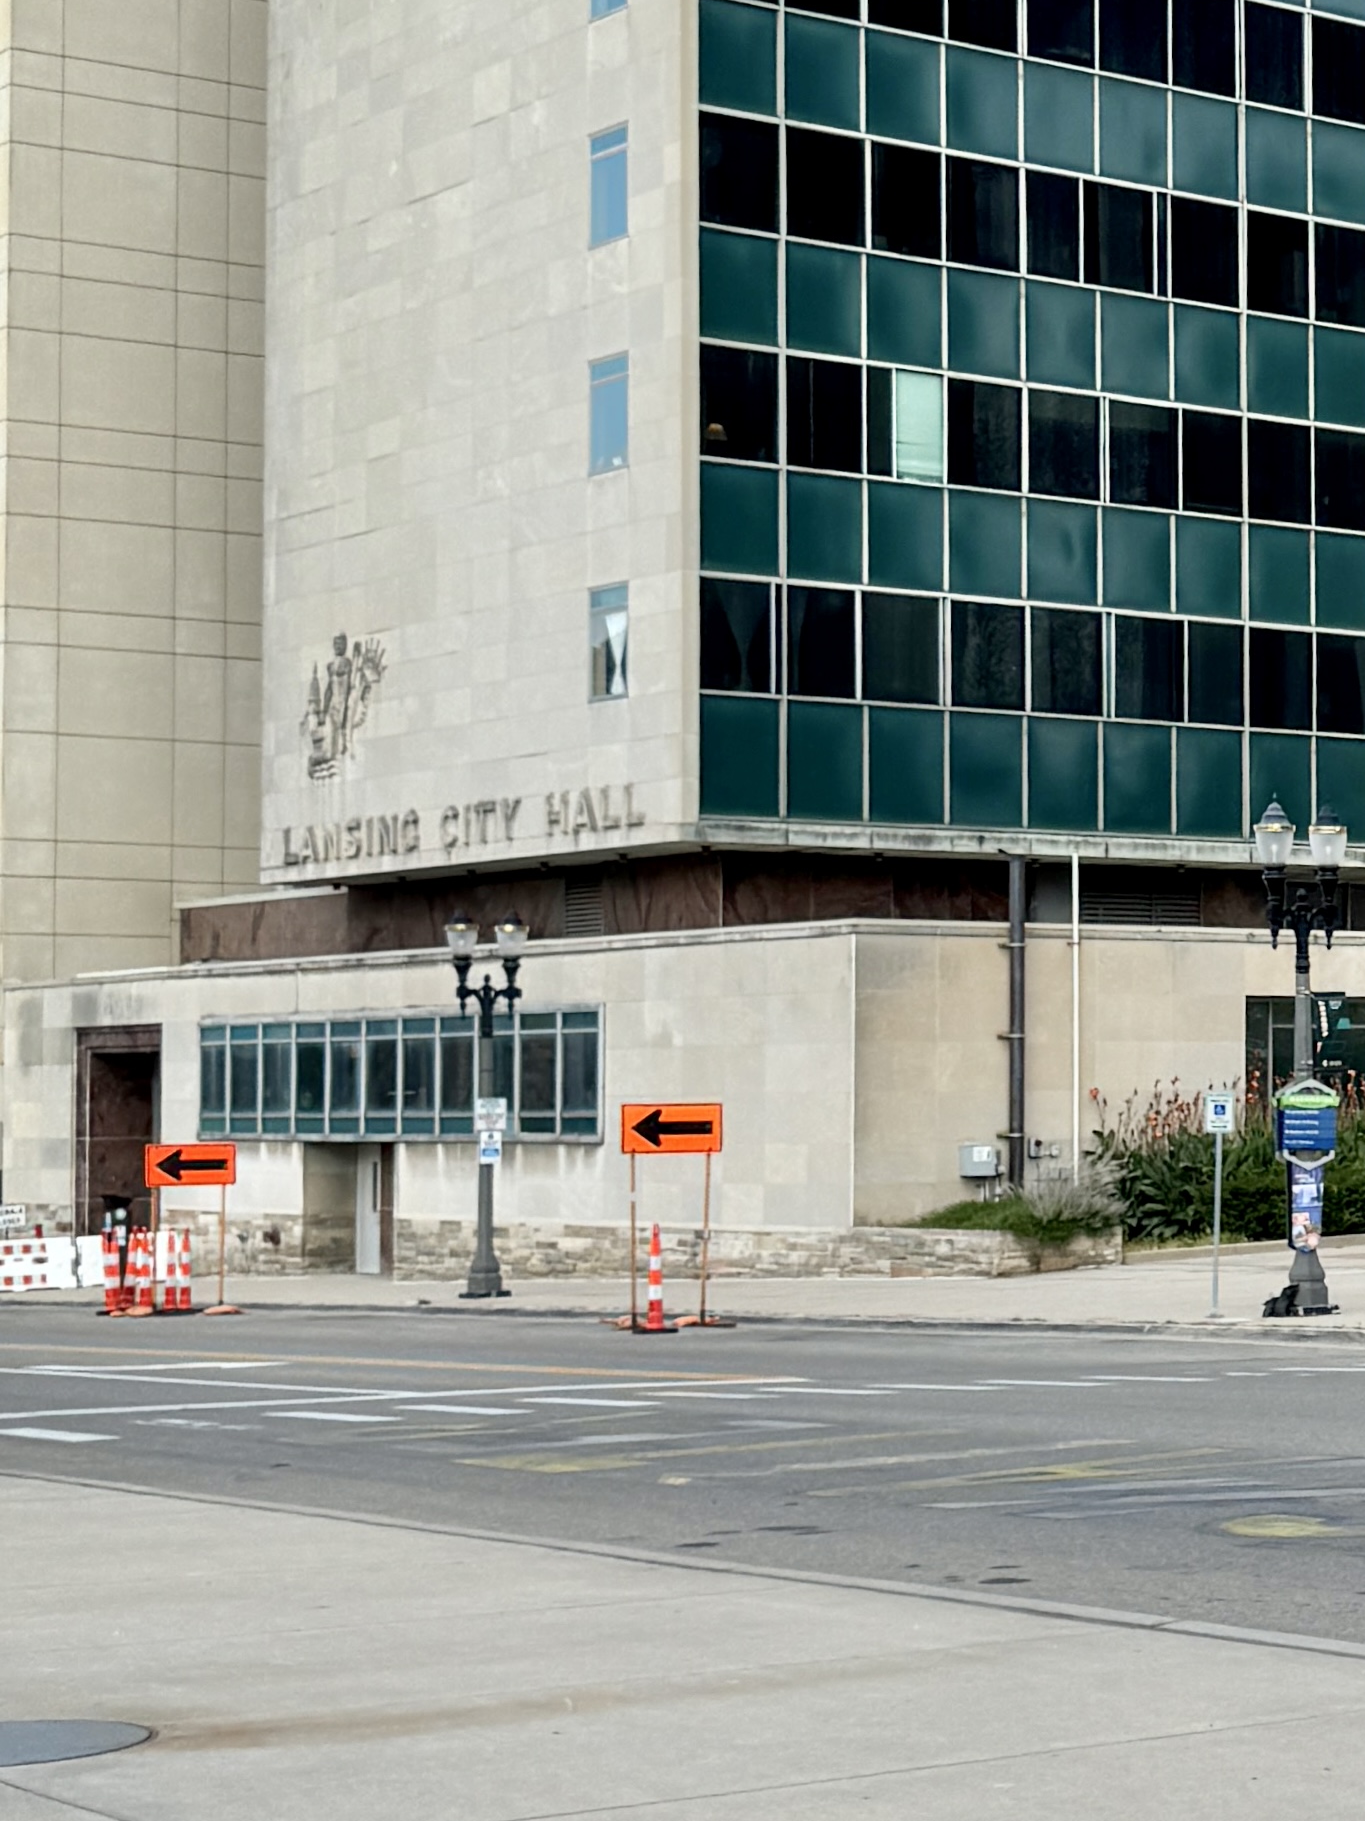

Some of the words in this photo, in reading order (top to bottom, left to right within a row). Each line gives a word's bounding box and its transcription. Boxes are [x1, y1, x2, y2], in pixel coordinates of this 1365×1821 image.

[283, 807, 421, 866] LANSING
[439, 796, 522, 852] CITY
[545, 783, 645, 837] HALL
